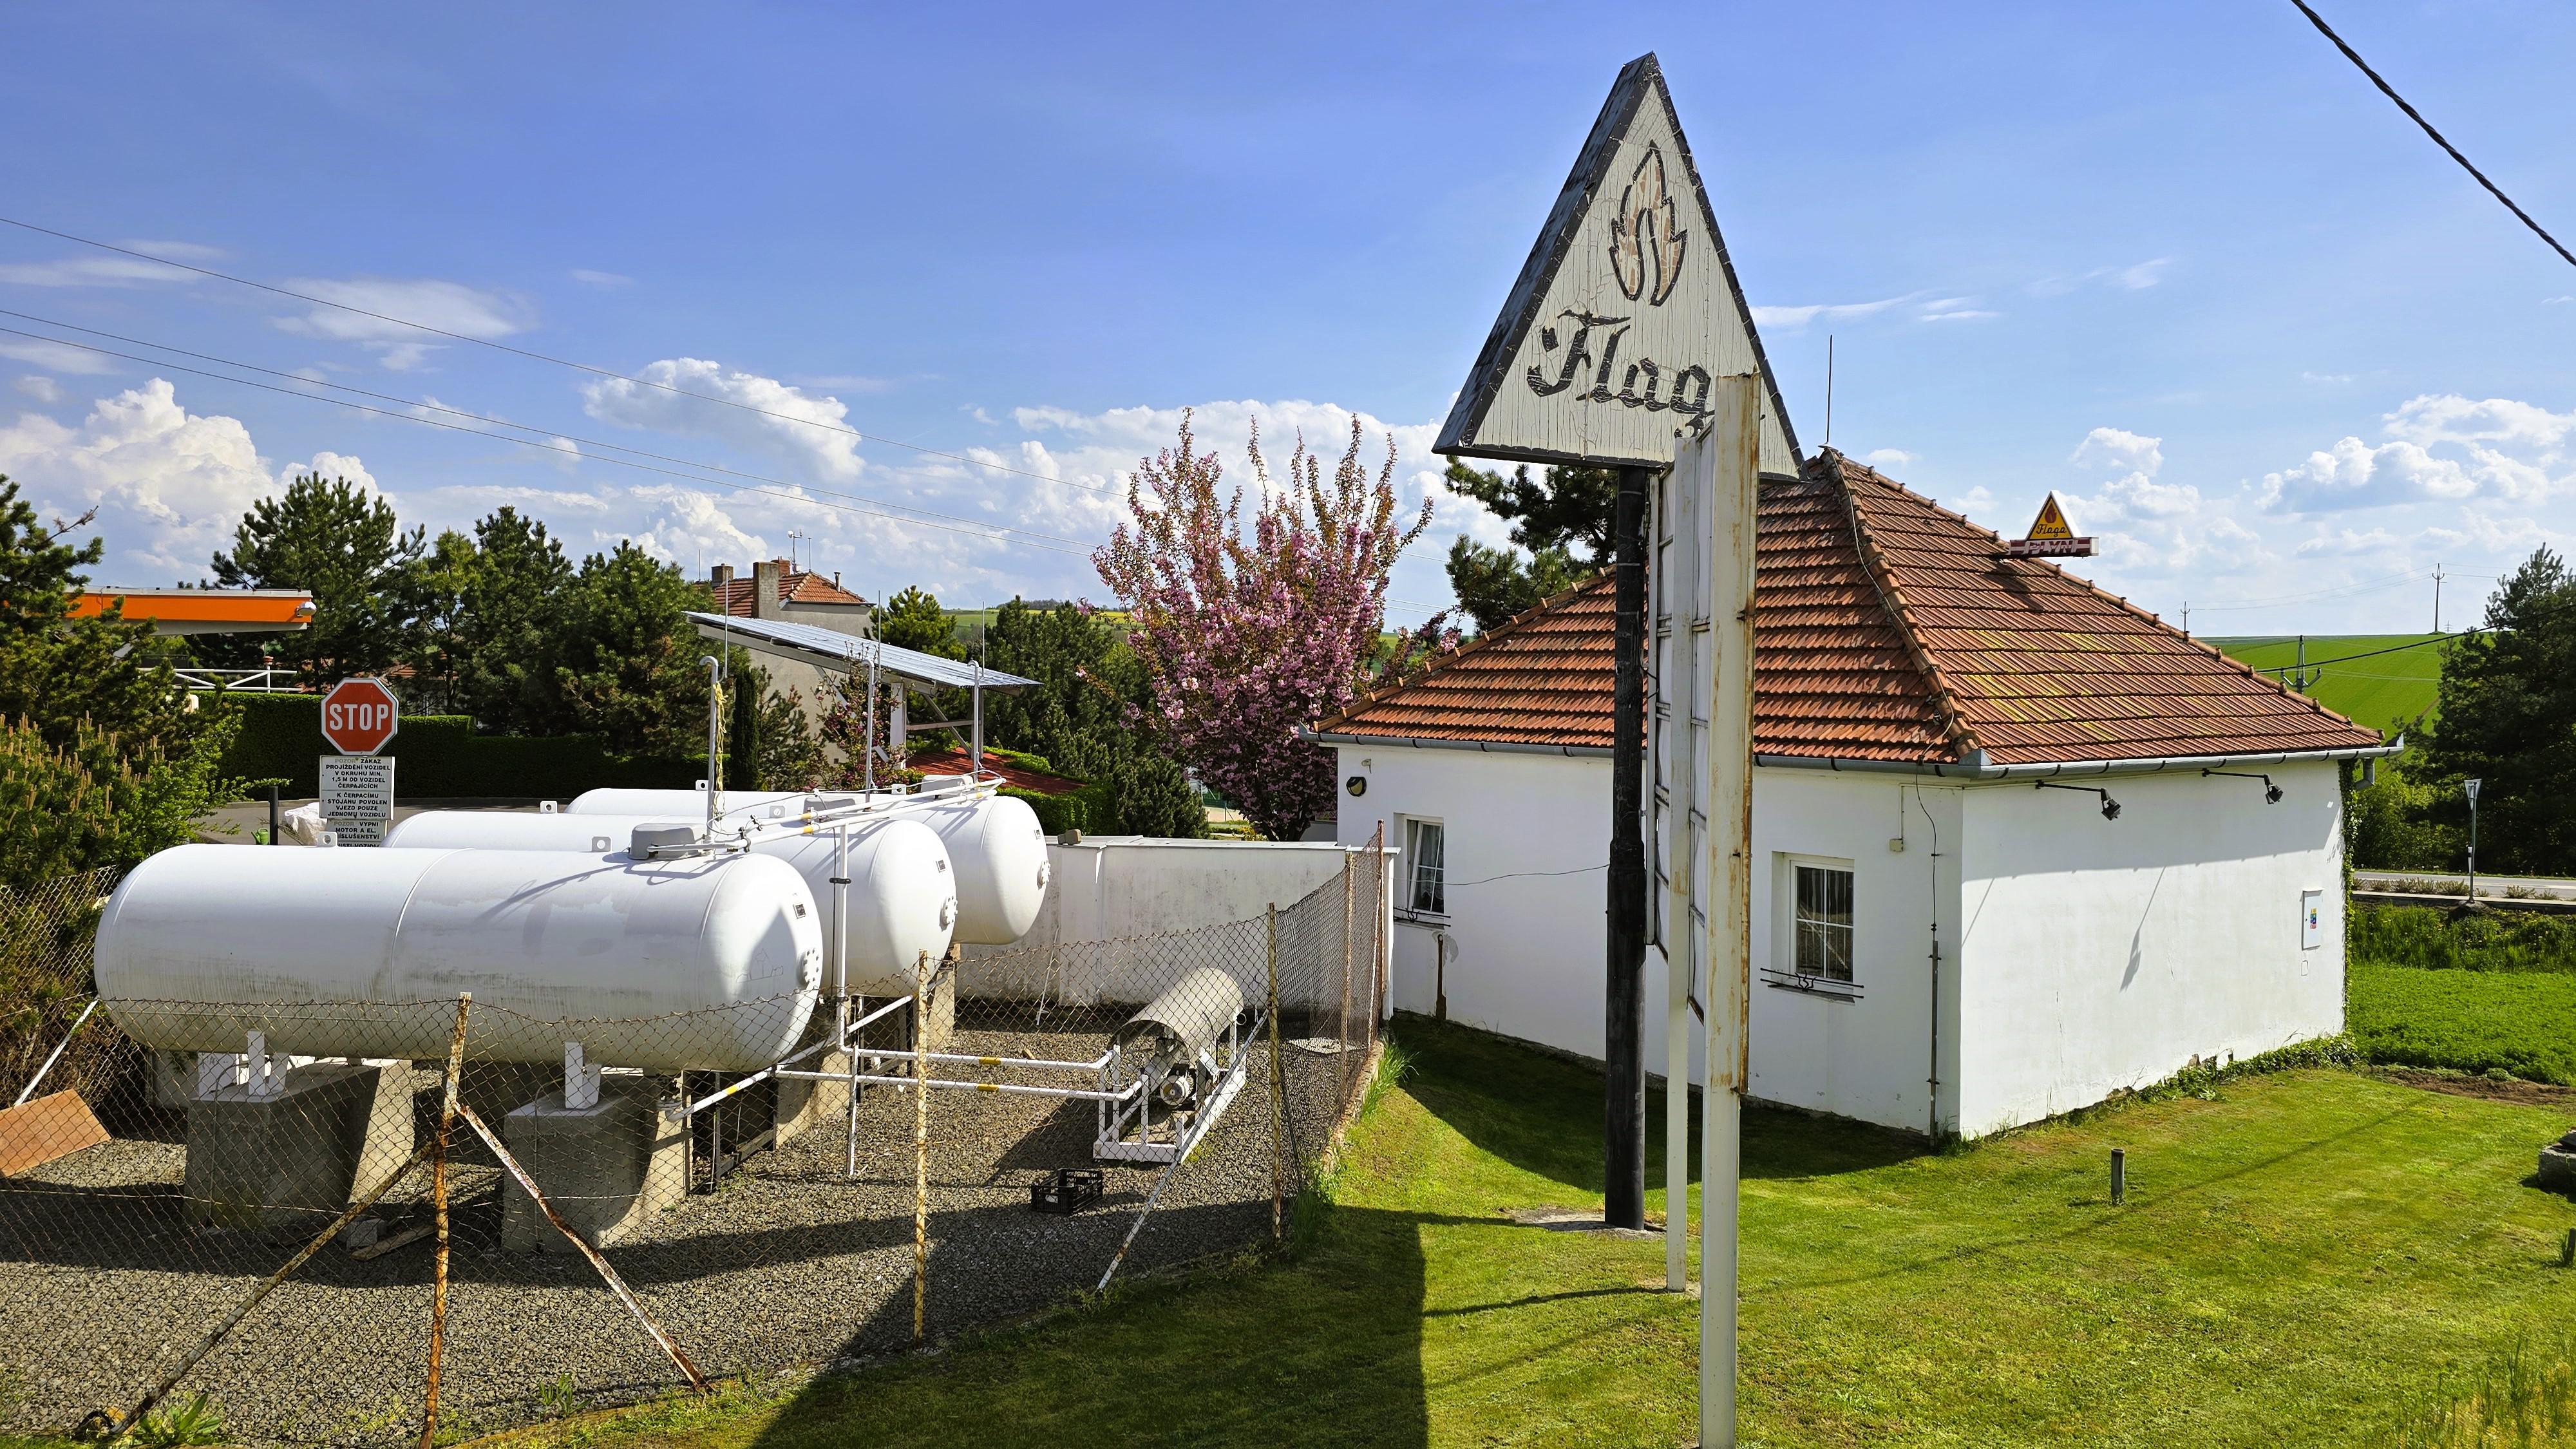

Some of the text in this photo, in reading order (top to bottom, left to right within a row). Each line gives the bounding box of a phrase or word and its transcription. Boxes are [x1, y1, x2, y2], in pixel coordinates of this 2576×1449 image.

[1527, 308, 1716, 438] Flag
[2036, 524, 2067, 537] Flaga
[329, 703, 389, 731] STOP
